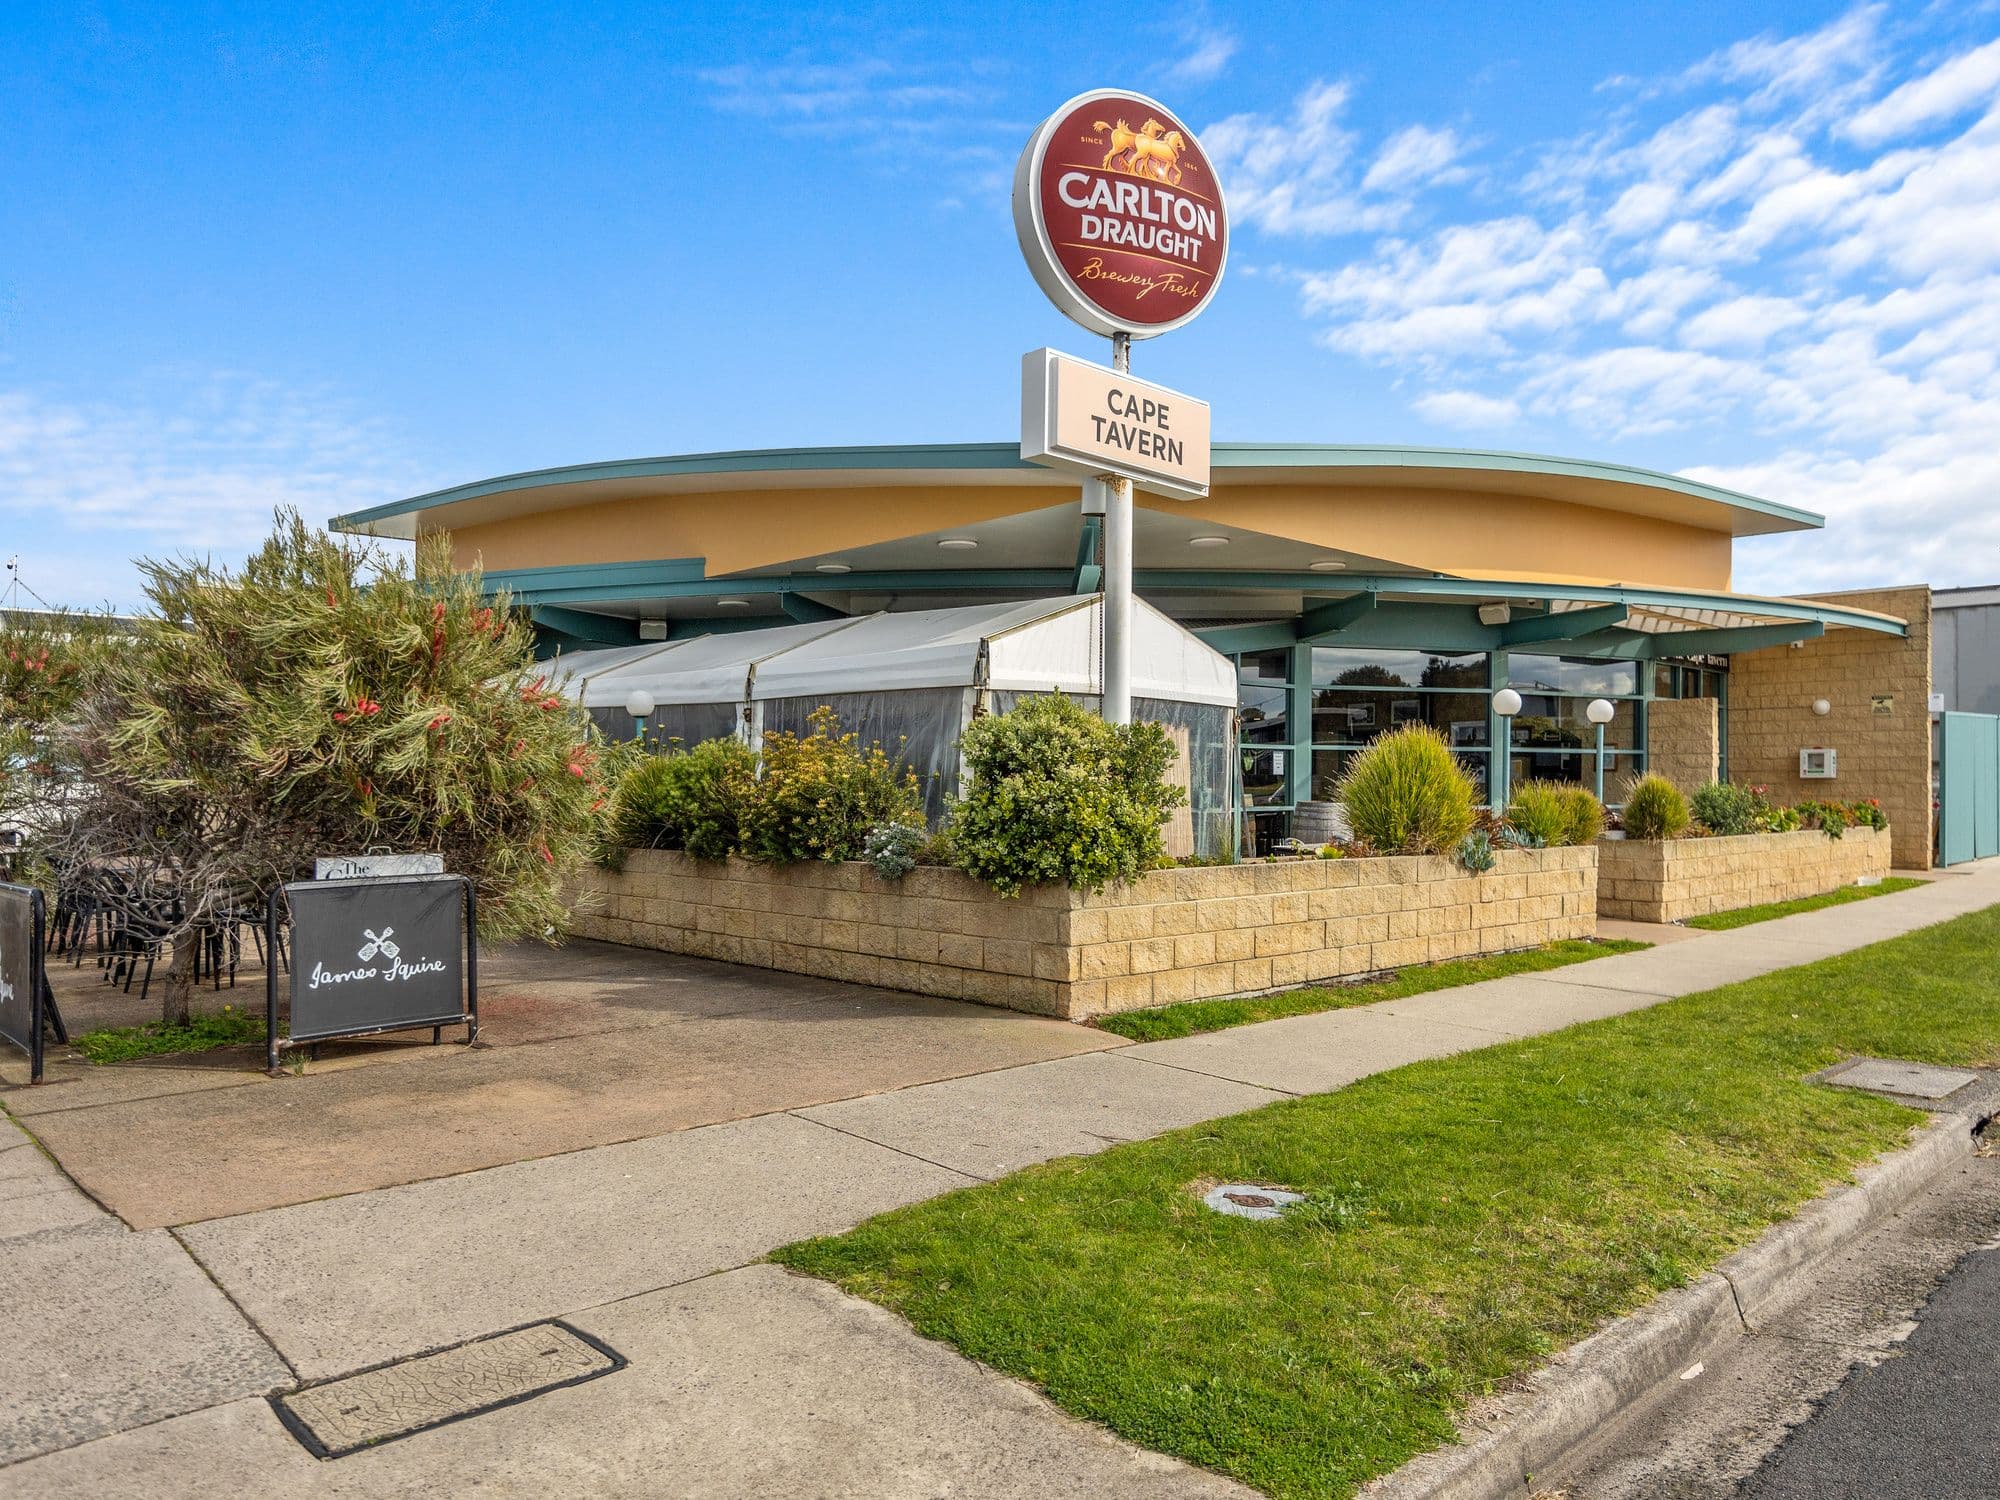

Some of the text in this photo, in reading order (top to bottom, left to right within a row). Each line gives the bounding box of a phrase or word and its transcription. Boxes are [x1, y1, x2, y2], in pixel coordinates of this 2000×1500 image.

[1081, 136, 1104, 145] SINCE
[1058, 172, 1217, 242] CARLTON
[1080, 214, 1203, 263] DRAUGHT
[1076, 257, 1199, 300] Brewery Fresh
[1107, 389, 1170, 430] CAPE
[1091, 414, 1184, 466] TAVERN
[341, 862, 370, 875] The
[309, 956, 446, 989] James Squire
